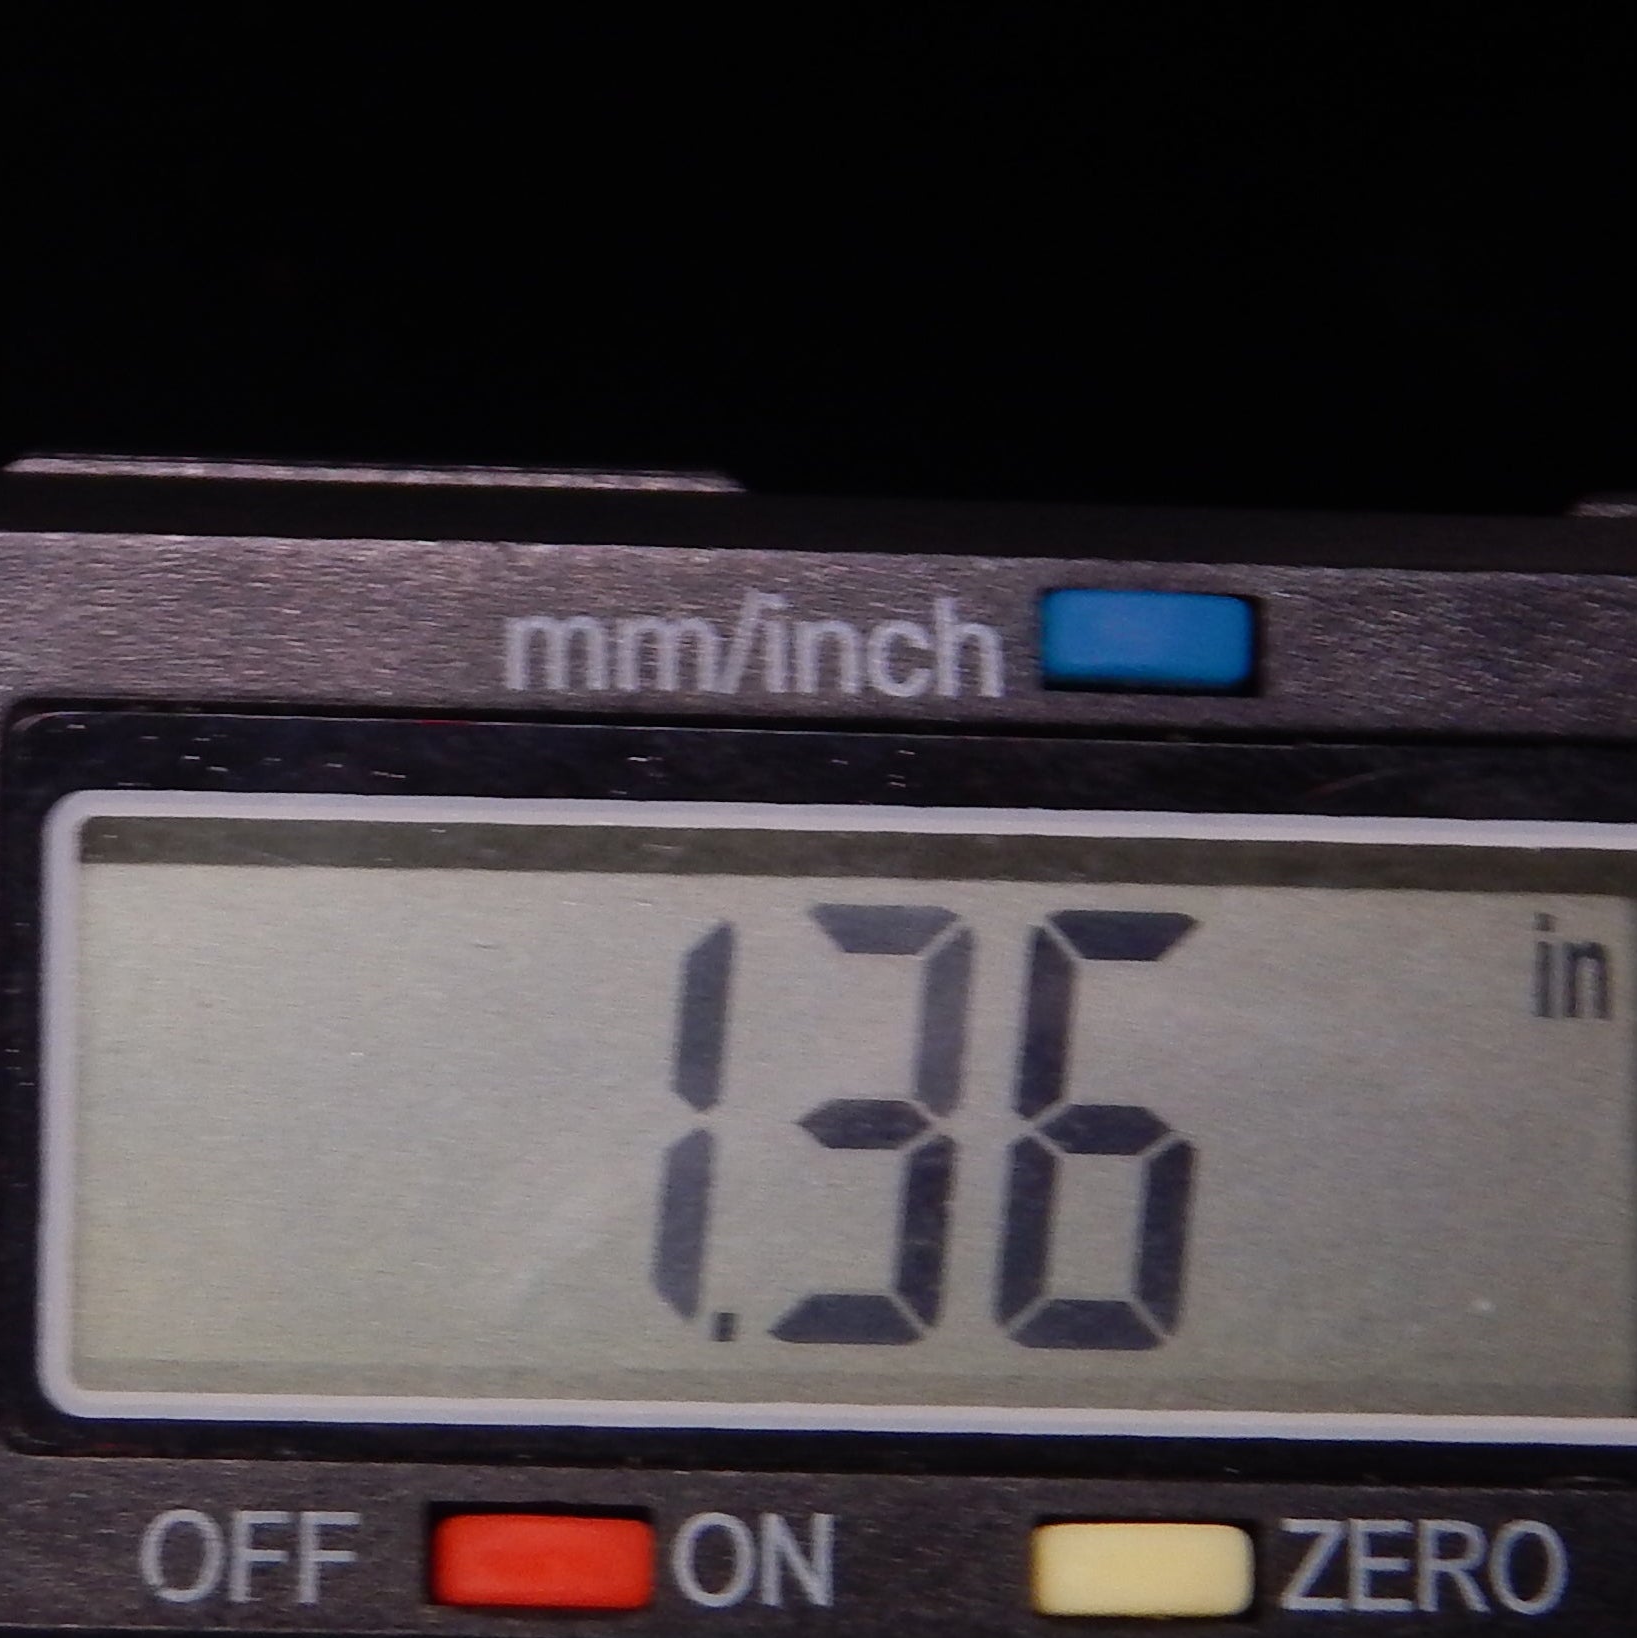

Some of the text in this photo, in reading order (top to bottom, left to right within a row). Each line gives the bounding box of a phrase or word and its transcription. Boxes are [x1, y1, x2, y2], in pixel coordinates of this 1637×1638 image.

[503, 595, 1005, 698] mm/inch
[650, 903, 1615, 1352] 1.36 in
[139, 1509, 1568, 1616] OFF ON ZERO
